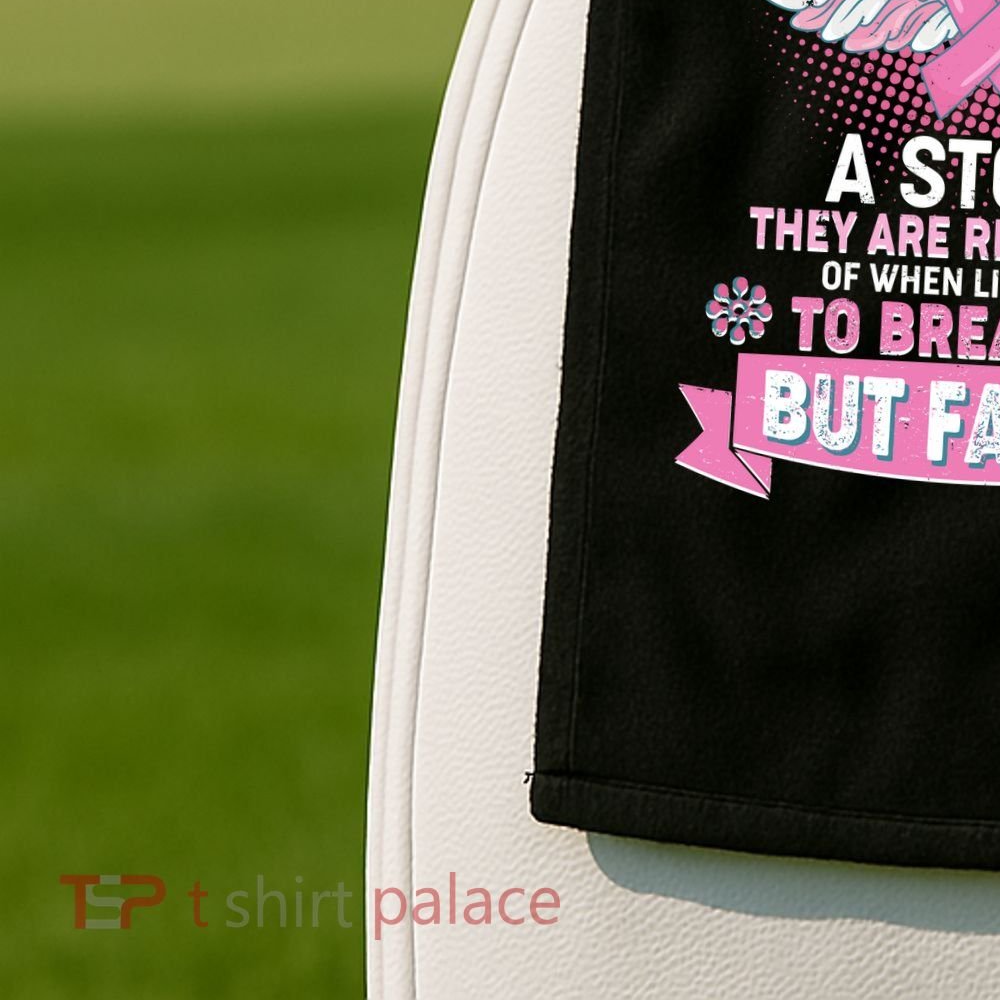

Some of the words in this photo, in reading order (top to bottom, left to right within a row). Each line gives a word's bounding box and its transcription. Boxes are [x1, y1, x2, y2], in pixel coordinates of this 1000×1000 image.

[825, 133, 875, 204] A
[749, 206, 858, 253] THEY
[867, 214, 950, 259] ARE
[821, 260, 860, 291] OF
[869, 264, 963, 296] WHEN
[791, 296, 860, 355] TO
[762, 368, 908, 459] BUT
